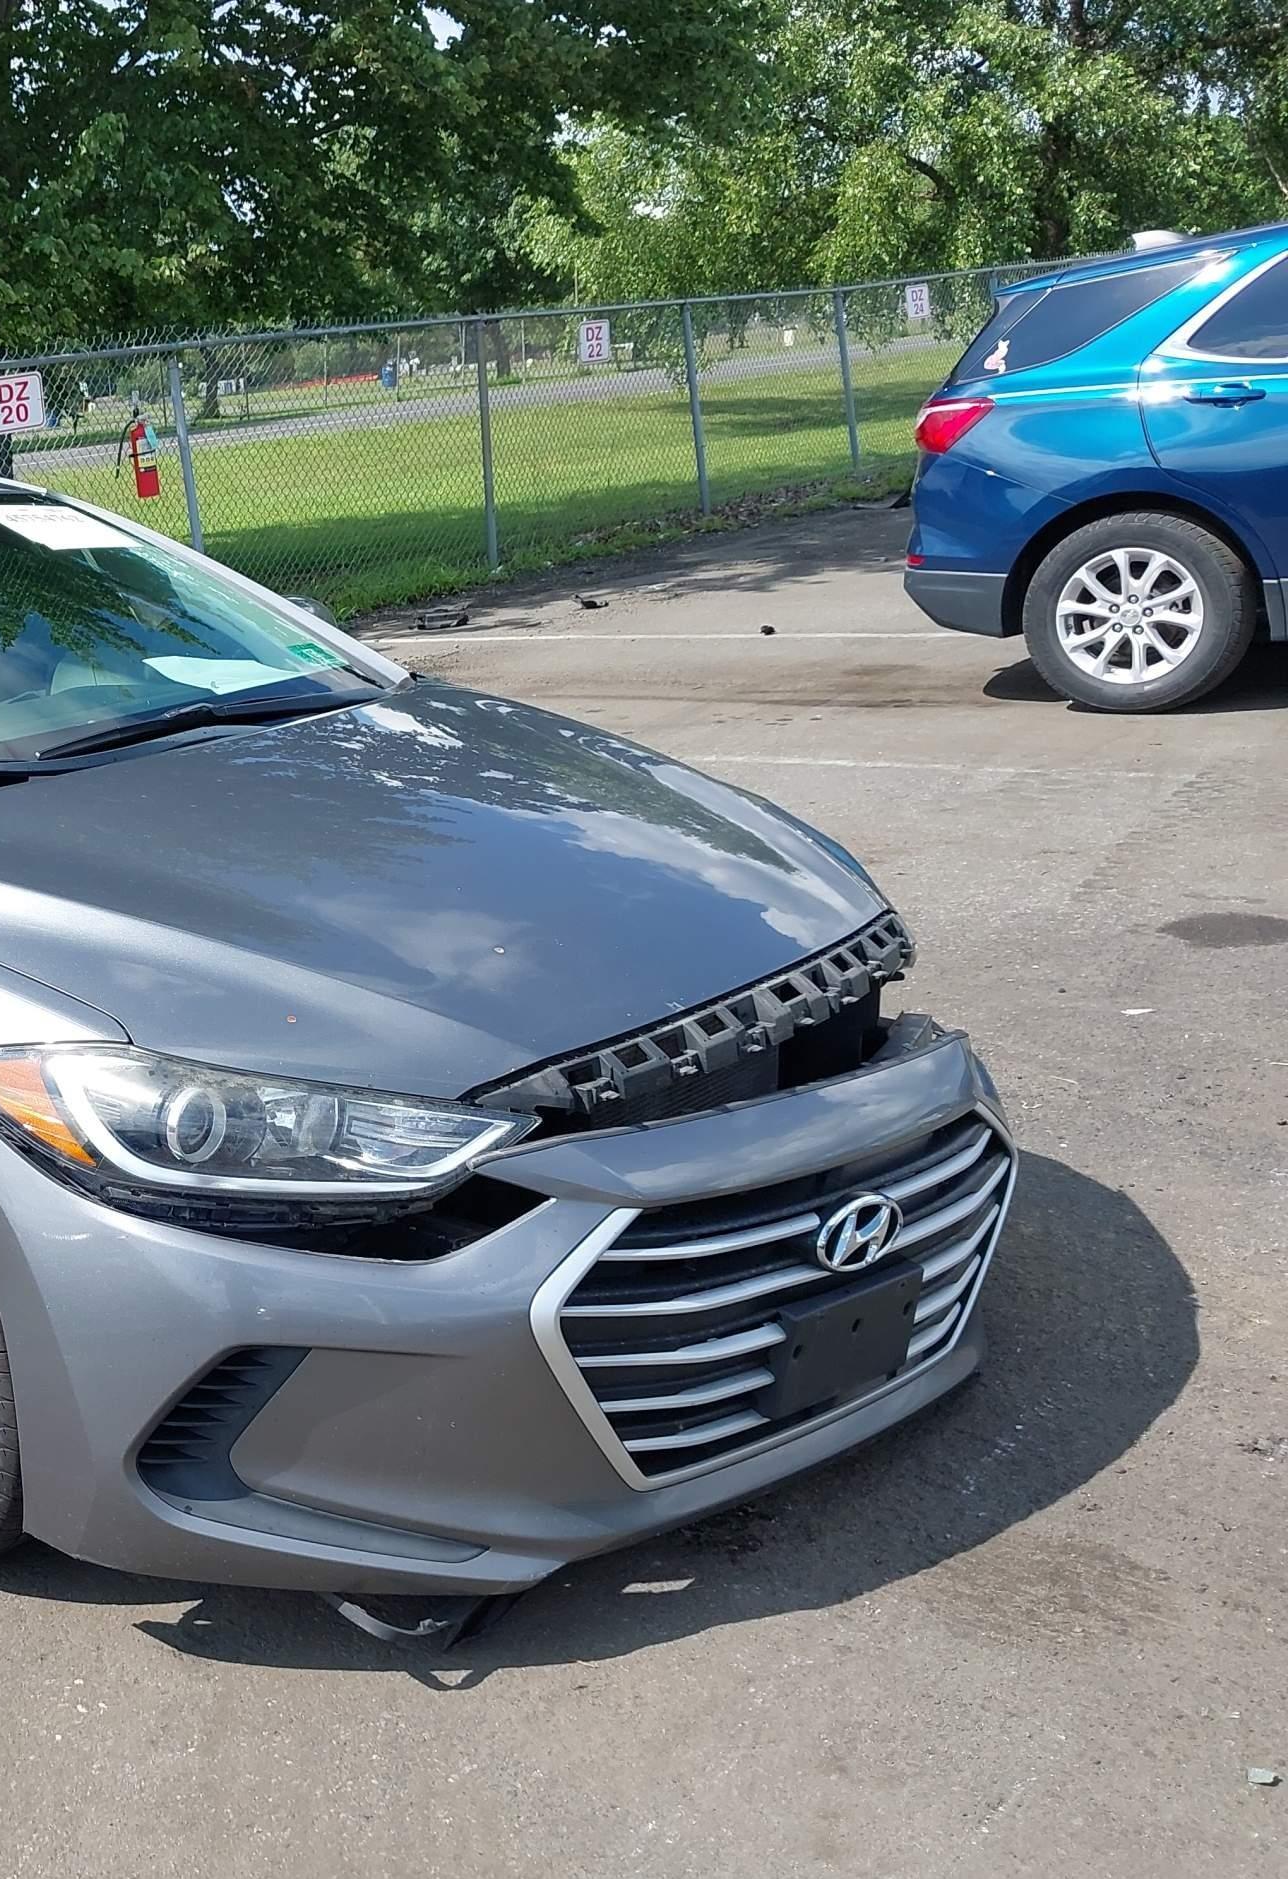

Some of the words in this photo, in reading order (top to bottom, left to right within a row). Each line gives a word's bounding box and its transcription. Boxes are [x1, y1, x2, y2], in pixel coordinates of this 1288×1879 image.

[911, 289, 924, 302] DZ
[913, 303, 924, 315] 24
[586, 326, 602, 341] DZ
[588, 343, 602, 358] 22
[1, 403, 28, 424] 20
